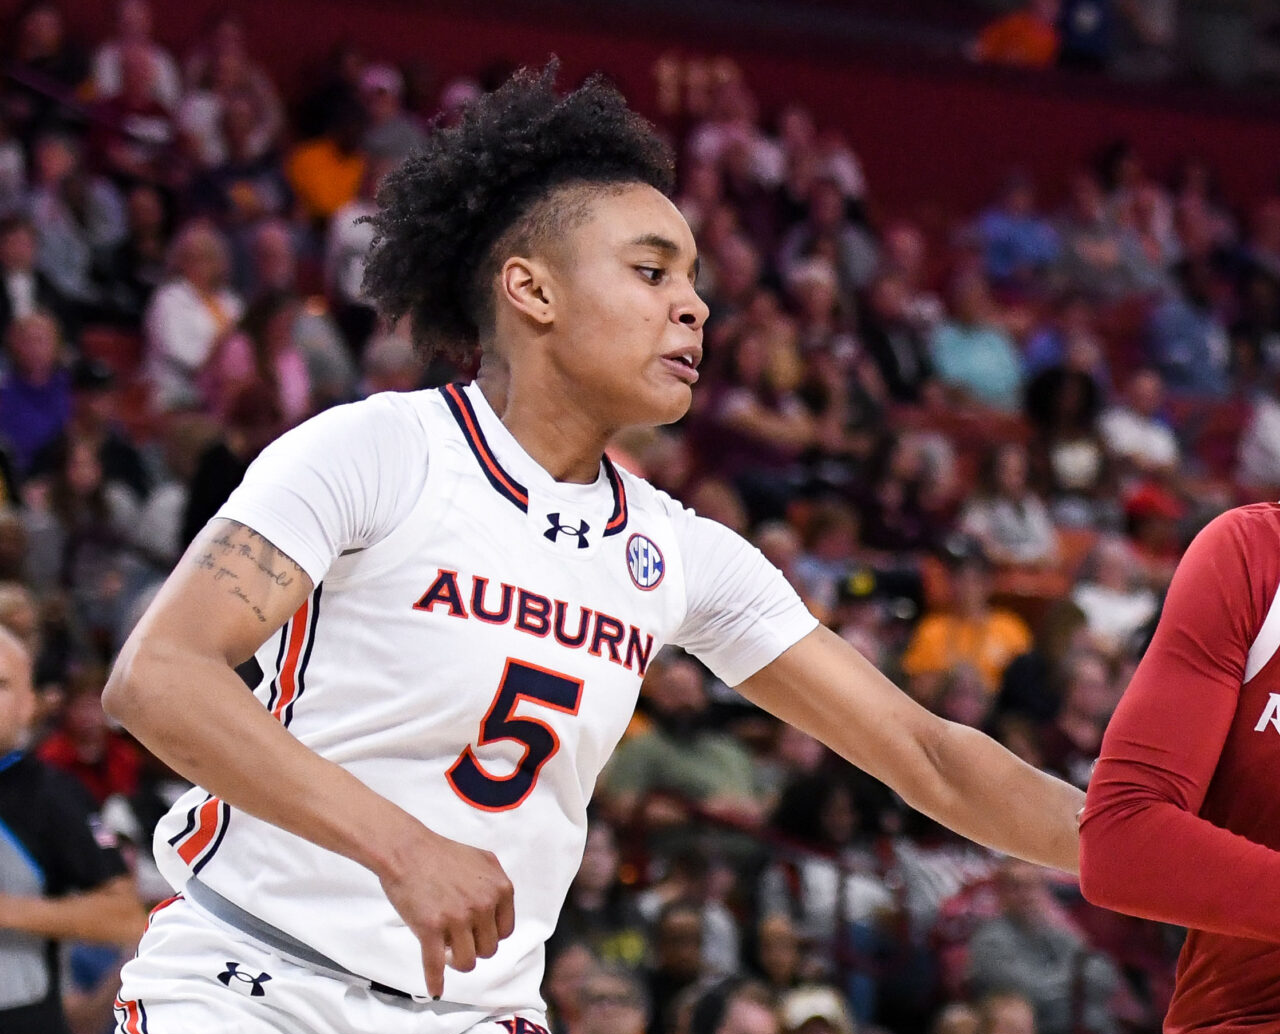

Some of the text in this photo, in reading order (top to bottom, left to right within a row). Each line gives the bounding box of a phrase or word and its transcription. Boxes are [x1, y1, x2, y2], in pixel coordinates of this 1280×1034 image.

[628, 534, 665, 591] SEC
[412, 568, 654, 679] AUBURN
[444, 656, 585, 813] 5
